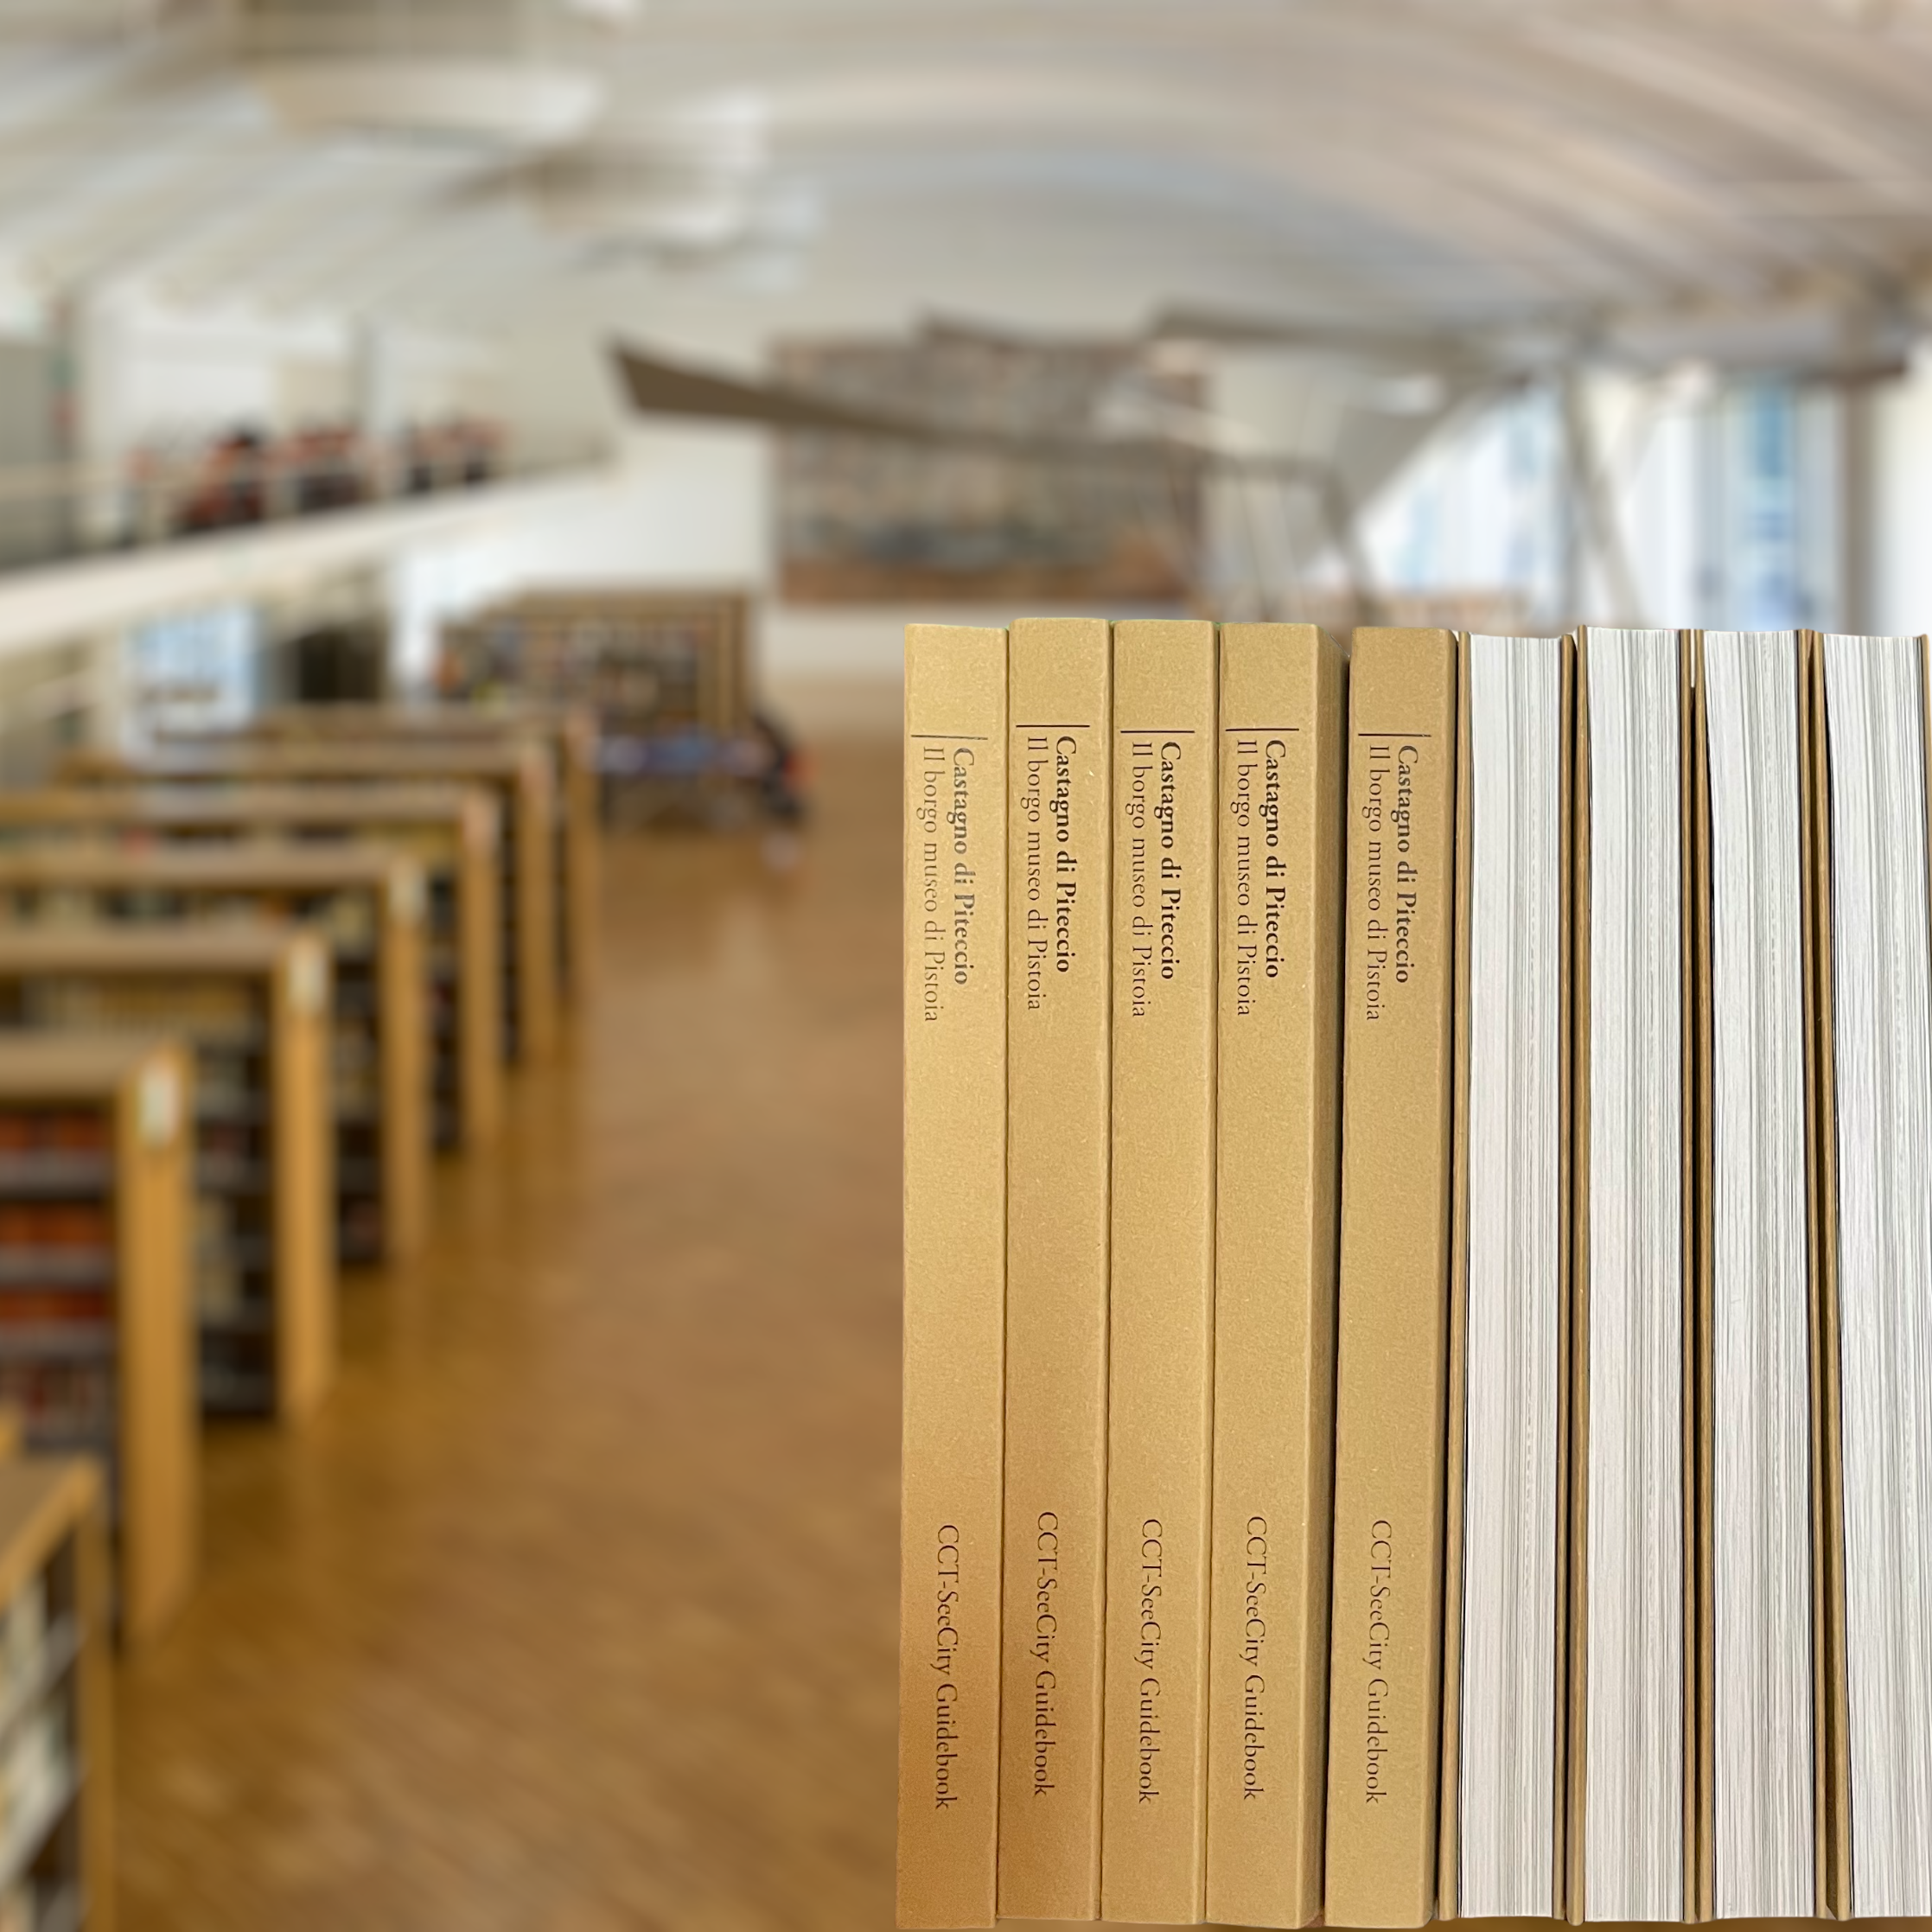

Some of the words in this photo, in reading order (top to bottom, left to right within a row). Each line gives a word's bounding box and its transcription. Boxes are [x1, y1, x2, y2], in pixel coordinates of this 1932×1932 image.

[922, 746, 946, 762] Il
[1026, 736, 1049, 751] Il
[1132, 742, 1154, 757] Il
[1236, 739, 1259, 755] Il
[1368, 745, 1391, 760] Il
[915, 770, 946, 834] borgo
[946, 746, 976, 855] Castagno
[1020, 760, 1049, 823] borgo
[1049, 736, 1078, 843] Castagno
[1125, 765, 1154, 829] borgo
[1153, 741, 1182, 850] Castagno
[1229, 763, 1259, 827] borgo
[1259, 738, 1287, 848] Castagno
[1361, 768, 1391, 832] borgo
[1390, 744, 1419, 853] Castagno
[922, 843, 938, 913] museo
[953, 862, 977, 884] di
[1026, 831, 1042, 902] museo
[1055, 850, 1078, 873] di
[1132, 838, 1146, 909] museo
[1160, 857, 1183, 880] di
[1236, 836, 1251, 907] museo
[1265, 855, 1287, 878] di
[1367, 841, 1382, 911] museo
[1396, 860, 1419, 883] di
[923, 920, 947, 940] di
[953, 893, 976, 985] Piteccio
[1026, 909, 1049, 930] di
[1055, 882, 1077, 973] Piteccio
[1132, 915, 1154, 936] di
[1160, 888, 1182, 980] Piteccio
[1236, 914, 1259, 935] di
[1265, 886, 1287, 979] Piteccio
[1367, 919, 1389, 940] di
[1394, 891, 1418, 984] Piteccio
[924, 950, 947, 1023] Pistoia
[1027, 938, 1049, 1011] Pistoia
[1132, 945, 1153, 1017] Pistoia
[1236, 944, 1258, 1017] Pistoia
[1366, 948, 1388, 1021] Pistoia
[929, 1524, 960, 1676] CCT-SeeCity
[1030, 1511, 1059, 1664] CCT-SeeCity
[1133, 1519, 1164, 1670] CCT-SeeCity
[1239, 1515, 1268, 1667] CCT-SeeCity
[1361, 1519, 1393, 1671] CCT-SeeCity
[934, 1683, 960, 1810] Guidebook
[1034, 1670, 1057, 1797] Guidebook
[1138, 1677, 1162, 1805] Guidebook
[1243, 1674, 1266, 1801] Guidebook
[1365, 1678, 1389, 1805] Guidebook
